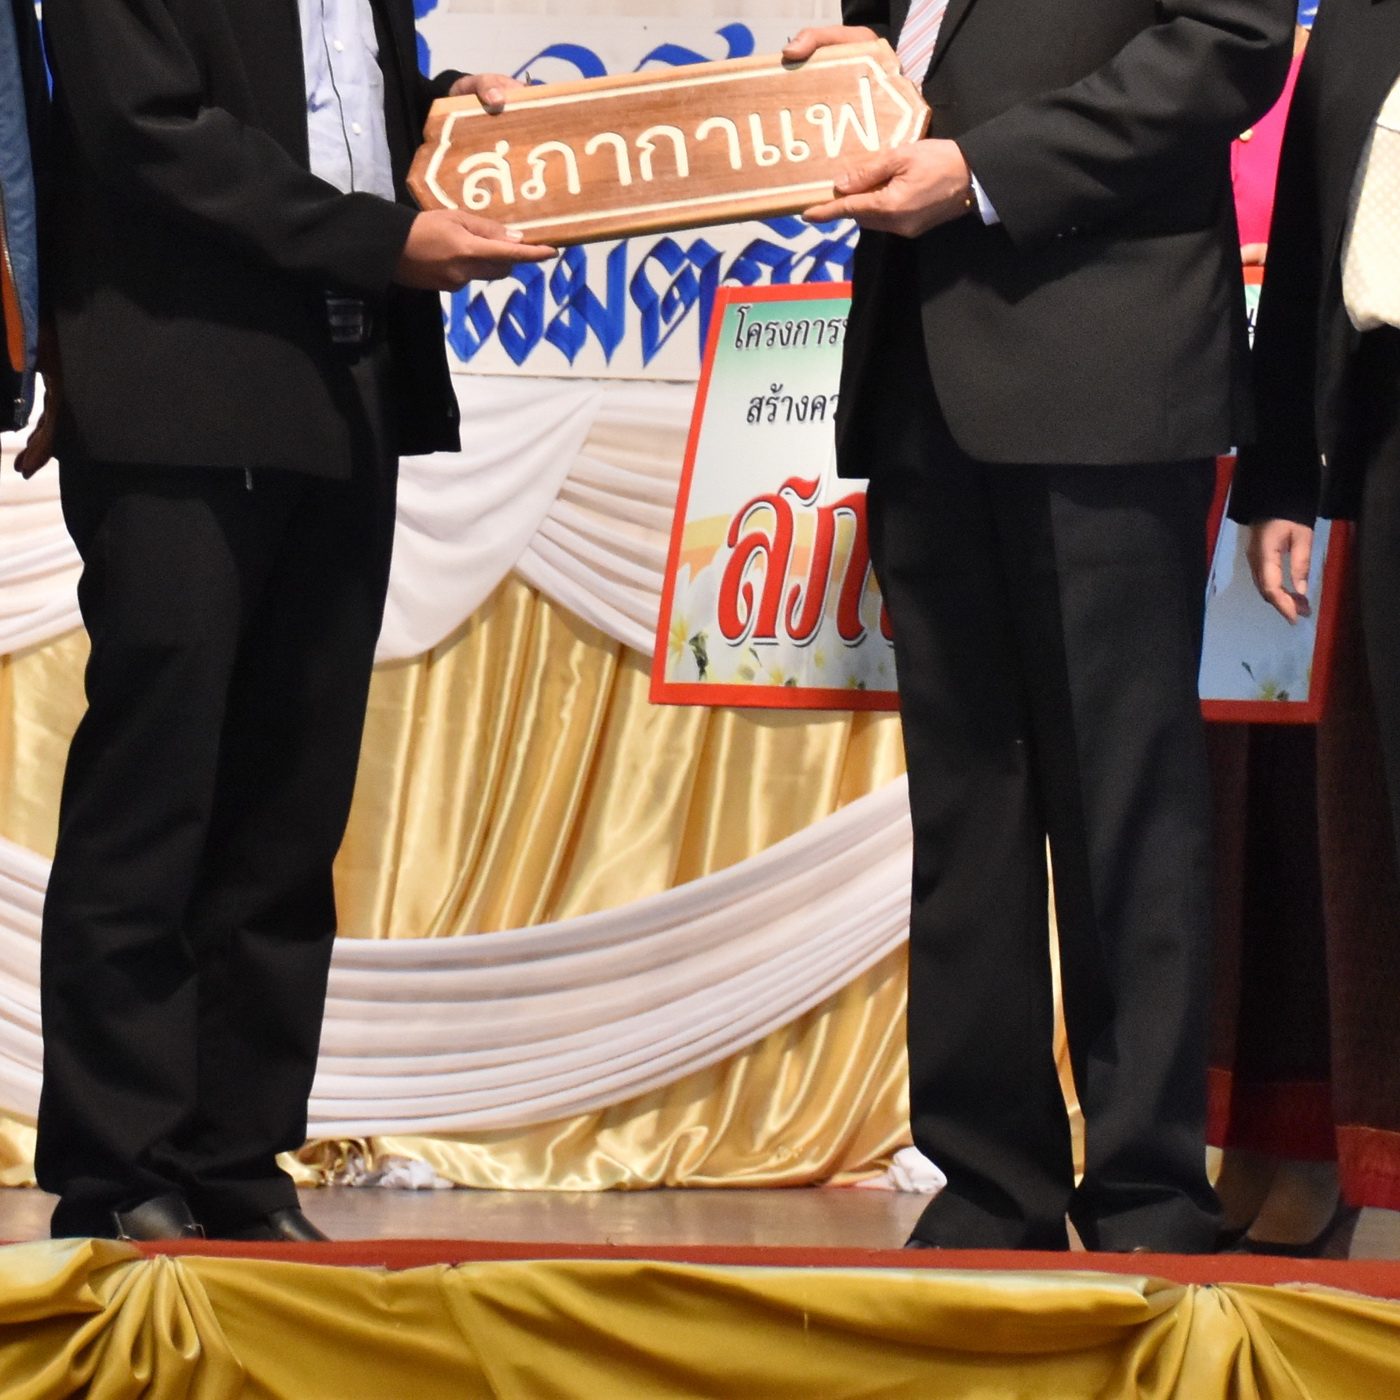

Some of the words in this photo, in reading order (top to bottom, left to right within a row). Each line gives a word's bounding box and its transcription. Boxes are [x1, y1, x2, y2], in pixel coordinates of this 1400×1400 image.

[456, 75, 882, 212] สภากาแฟ
[734, 304, 848, 350] โครงการ
[716, 474, 894, 647] สภ
